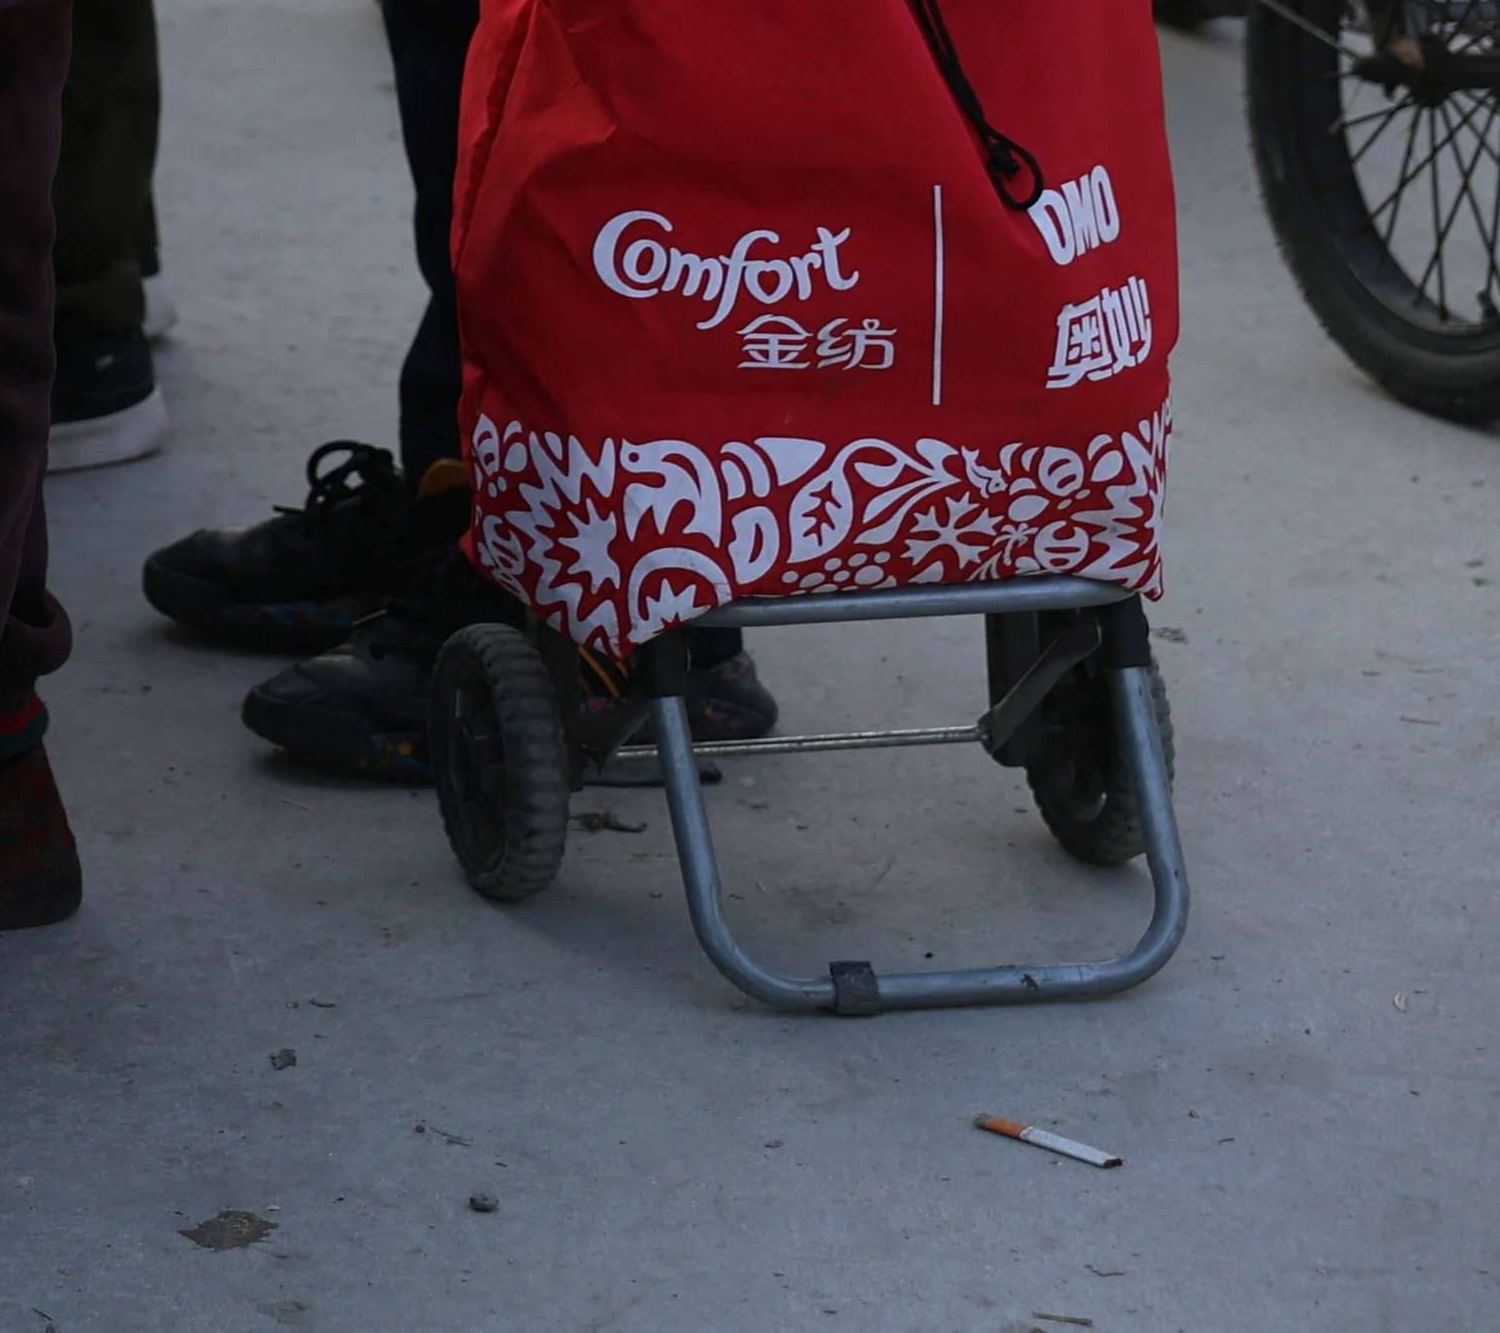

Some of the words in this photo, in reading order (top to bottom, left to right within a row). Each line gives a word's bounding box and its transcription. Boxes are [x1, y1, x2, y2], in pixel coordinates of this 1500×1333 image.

[1026, 164, 1121, 266] DMO
[593, 210, 860, 330] Comfort
[735, 314, 898, 371] 金纺
[1045, 275, 1153, 389] 奥妙
